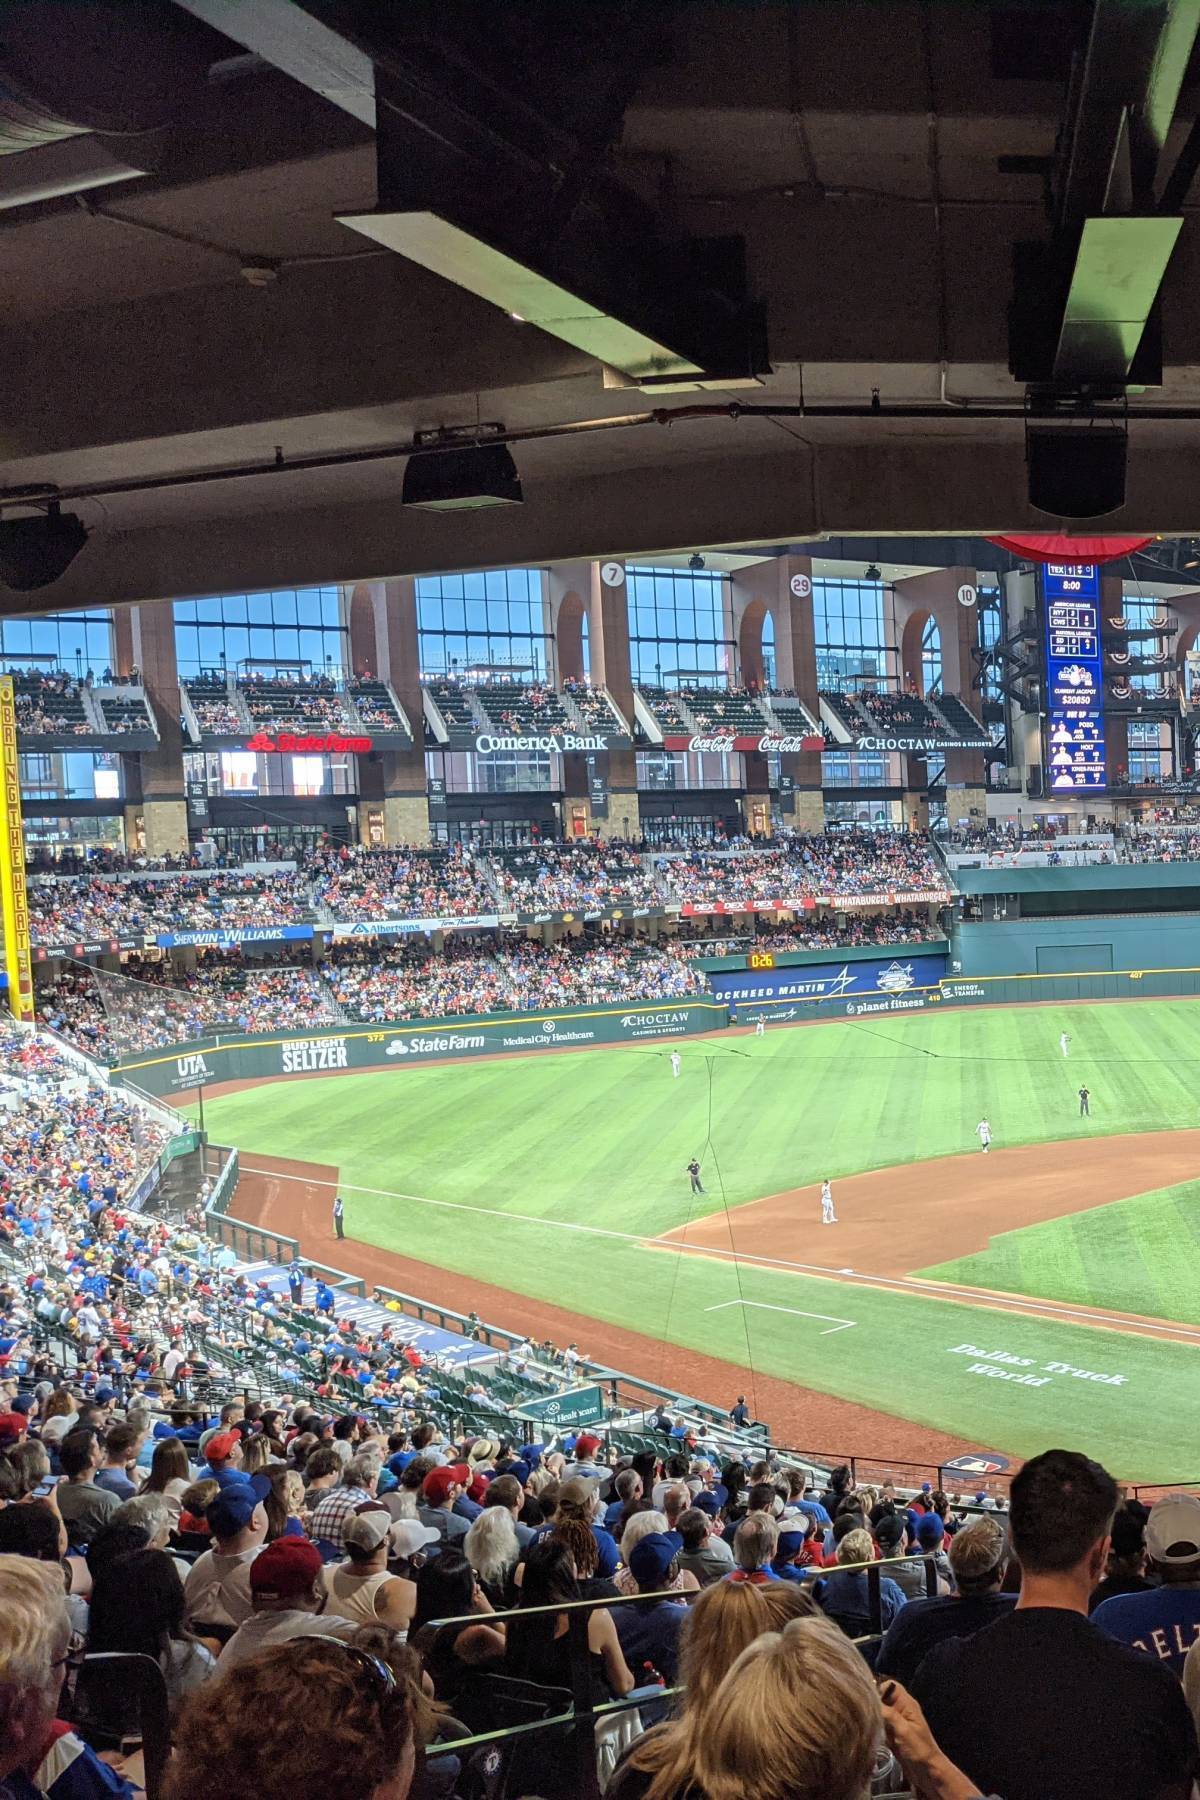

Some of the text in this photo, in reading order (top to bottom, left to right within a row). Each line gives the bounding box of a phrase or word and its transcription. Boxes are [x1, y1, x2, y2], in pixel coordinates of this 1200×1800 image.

[609, 567, 617, 581] 7
[793, 579, 808, 592] 29
[1063, 581, 1081, 590] 8:00
[961, 589, 972, 602] 10
[563, 734, 609, 750] Bank
[864, 736, 936, 751] CHOCTAW
[3, 706, 16, 802] BRING
[10, 810, 22, 866] THE
[752, 900, 774, 909] DEX
[782, 899, 802, 909] DEX
[833, 895, 889, 906] WHATABURGER
[893, 891, 948, 904] WHATABURGER
[14, 877, 27, 949] HEAT
[692, 903, 716, 912] DEX
[722, 902, 743, 912] DEX
[370, 923, 421, 934] Albertsons
[84, 945, 102, 953] TOYOTA
[119, 941, 136, 949] TOYOTA
[752, 954, 773, 968] 0:26
[715, 982, 826, 1001] OCKHEED MARTIN
[856, 999, 925, 1015] planet fitness
[628, 1012, 689, 1027] CHOCTAW
[282, 1038, 346, 1051] BUD LIGHT
[367, 1034, 384, 1042] 372
[503, 1030, 594, 1046] Medical City Healthcare
[177, 1054, 207, 1077] UTA
[282, 1046, 348, 1073] SELTZER
[947, 1343, 1129, 1386] Dallas Truck
[966, 1363, 1053, 1387] World
